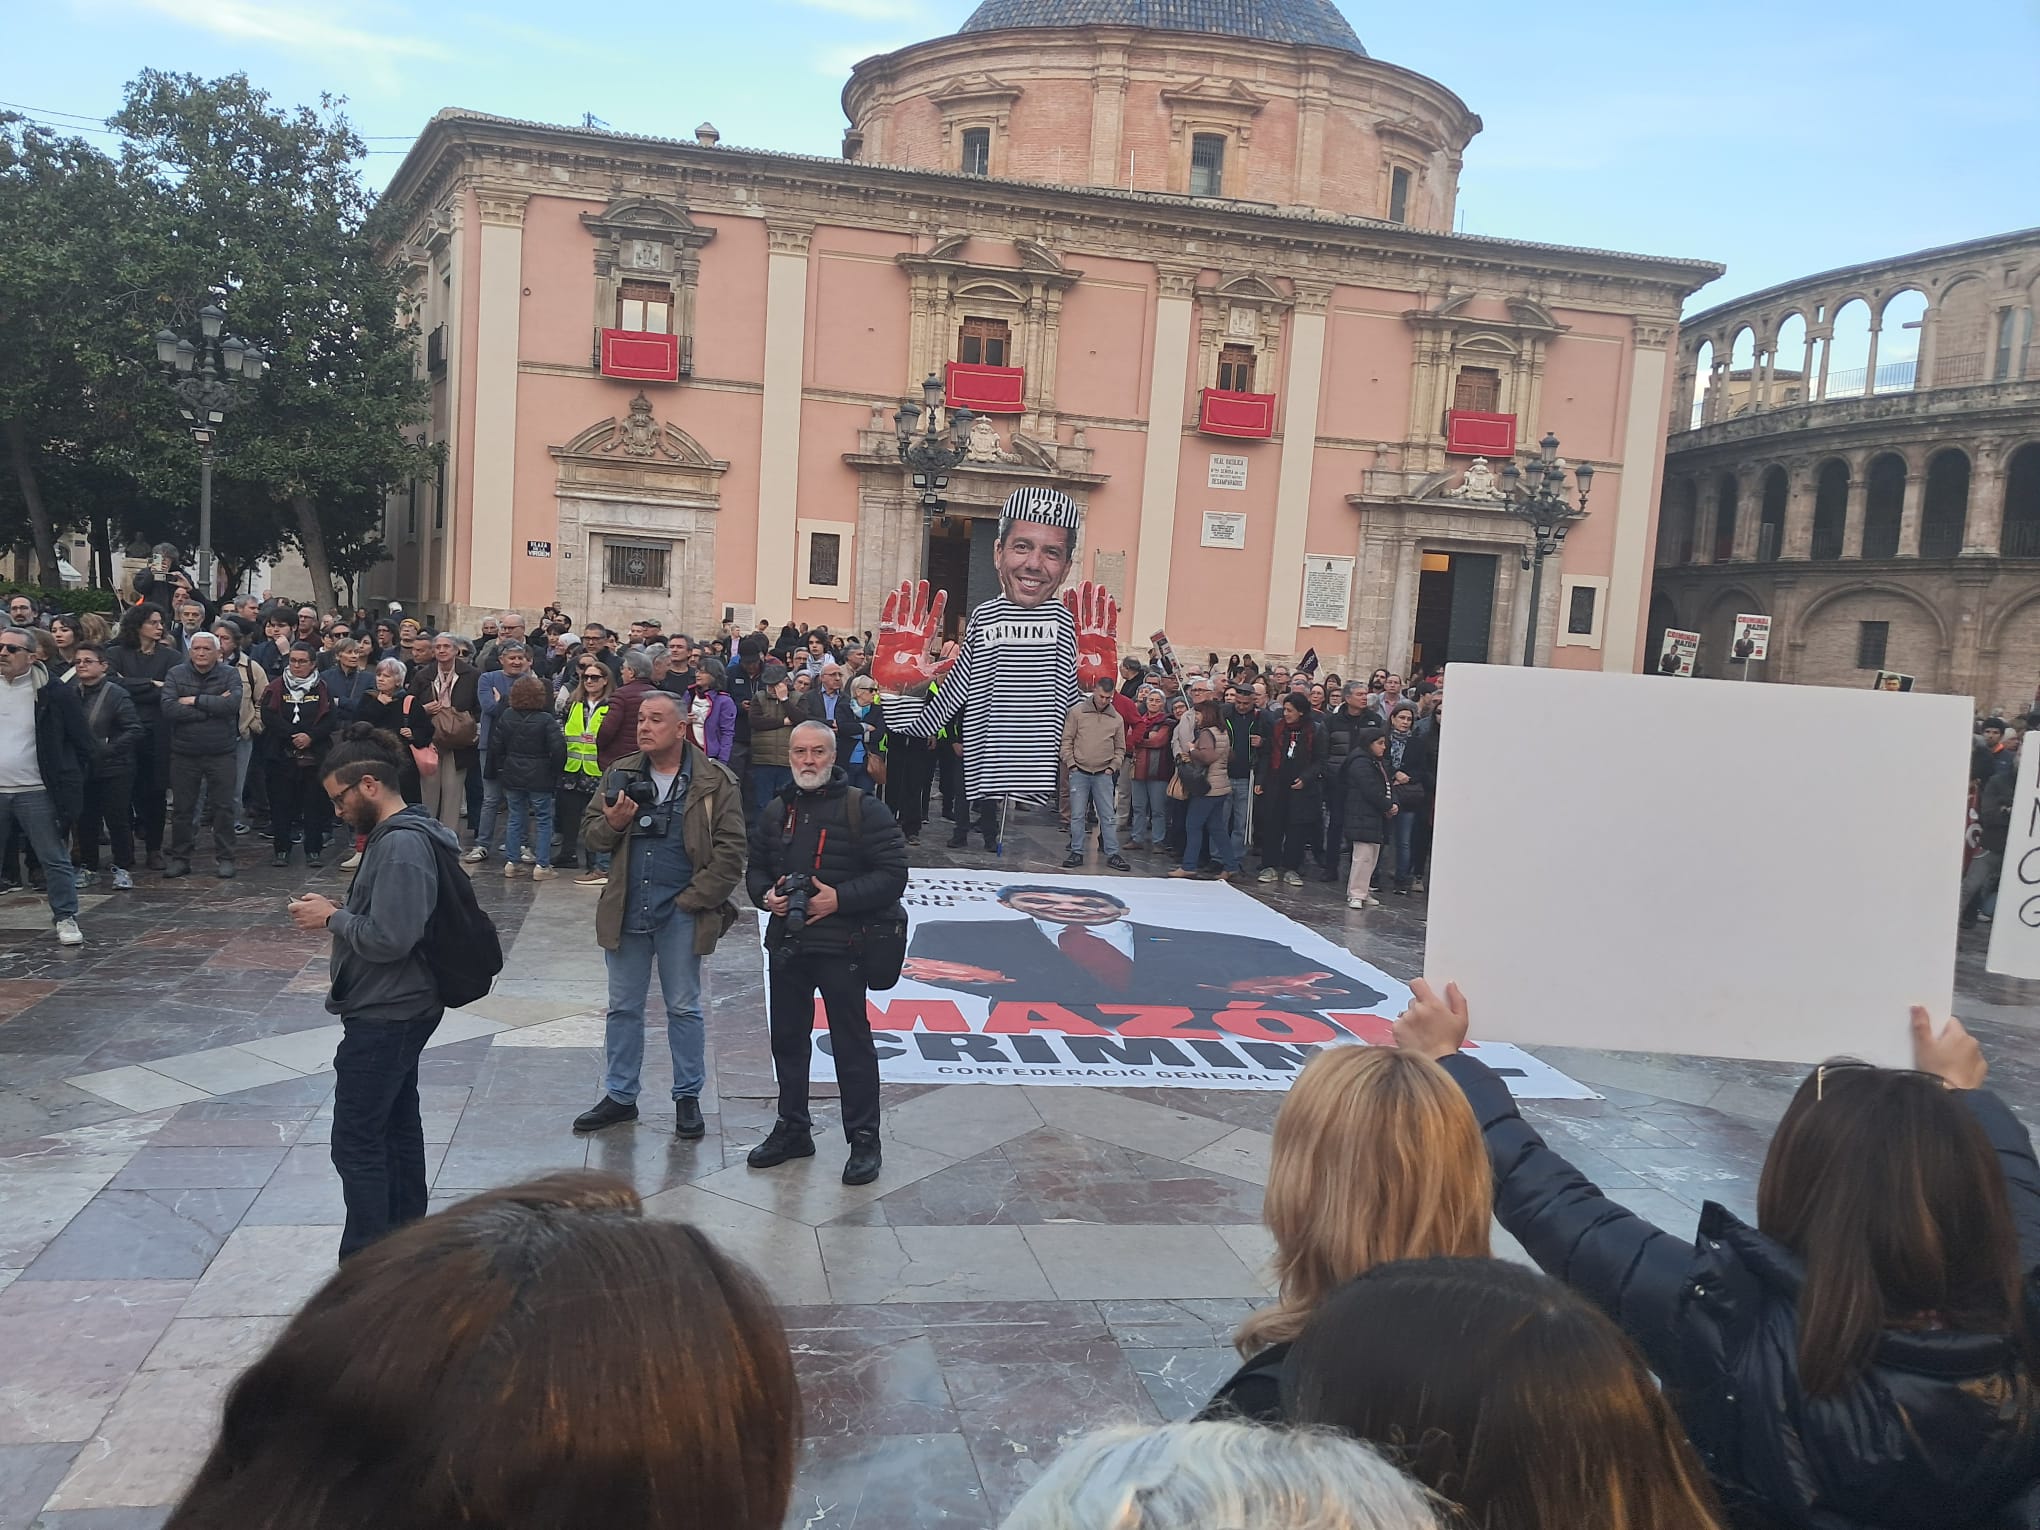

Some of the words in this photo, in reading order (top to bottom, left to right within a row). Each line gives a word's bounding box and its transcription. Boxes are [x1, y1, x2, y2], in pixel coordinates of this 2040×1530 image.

[1032, 499, 1063, 518] 228
[938, 1066, 1146, 1078] CONFEDERACIÓ
[1156, 1070, 1280, 1082] GENERAL
